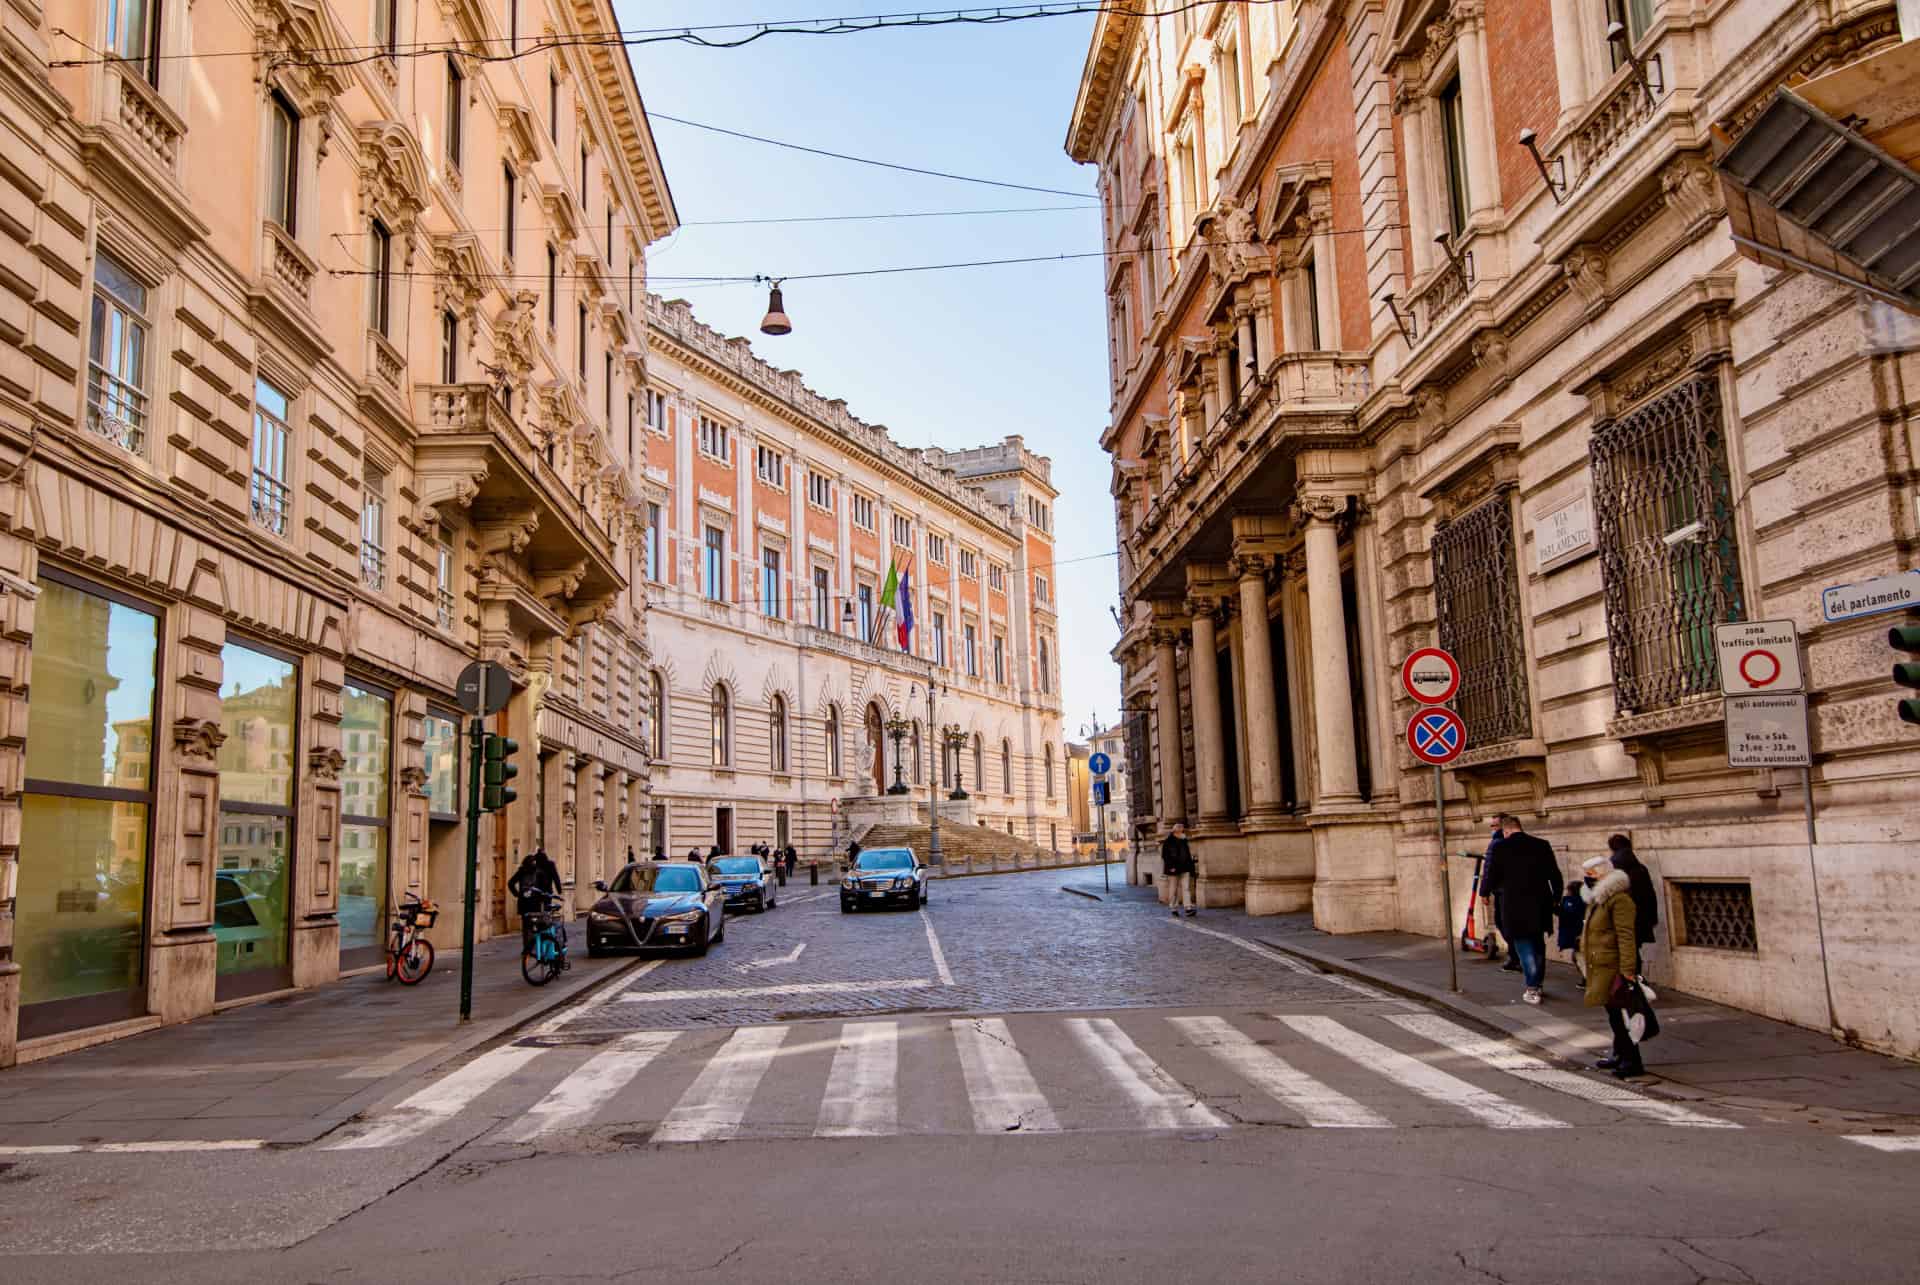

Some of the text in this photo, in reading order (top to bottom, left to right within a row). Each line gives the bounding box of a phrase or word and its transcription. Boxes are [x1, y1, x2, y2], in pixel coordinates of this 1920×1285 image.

[1553, 512, 1568, 529] VIA
[1540, 530, 1588, 562] PARLAMENTO
[1830, 587, 1911, 614] del parlamento
[1745, 627, 1765, 635] zona
[1721, 635, 1793, 649] traffico limitato
